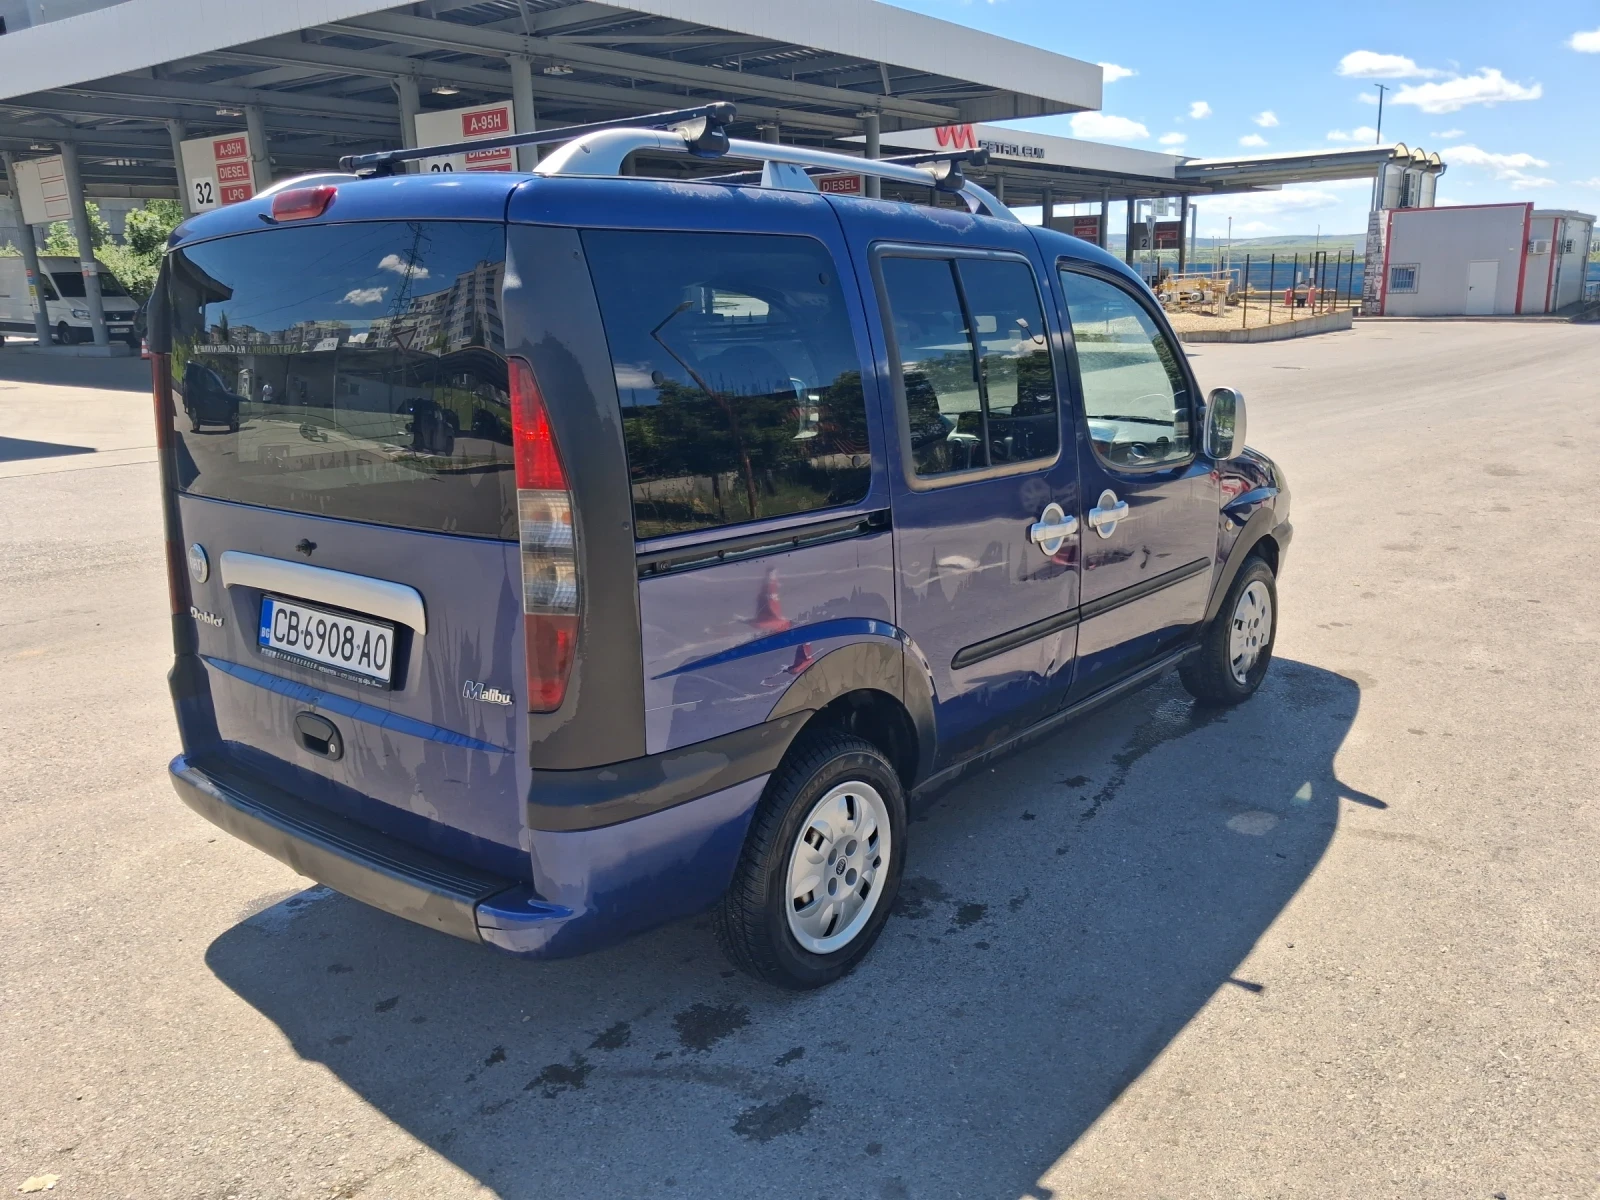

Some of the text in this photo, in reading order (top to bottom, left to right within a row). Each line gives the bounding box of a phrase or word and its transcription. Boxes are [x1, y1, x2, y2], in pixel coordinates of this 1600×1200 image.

[470, 113, 501, 131] A-95H
[220, 142, 242, 156] A-95H
[219, 165, 247, 179] DIESEL
[196, 182, 214, 204] 32
[822, 180, 857, 192] DIESEL
[228, 188, 245, 200] LPG
[1141, 238, 1148, 248] 2
[261, 627, 271, 639] BG
[462, 680, 512, 705] Malibu
